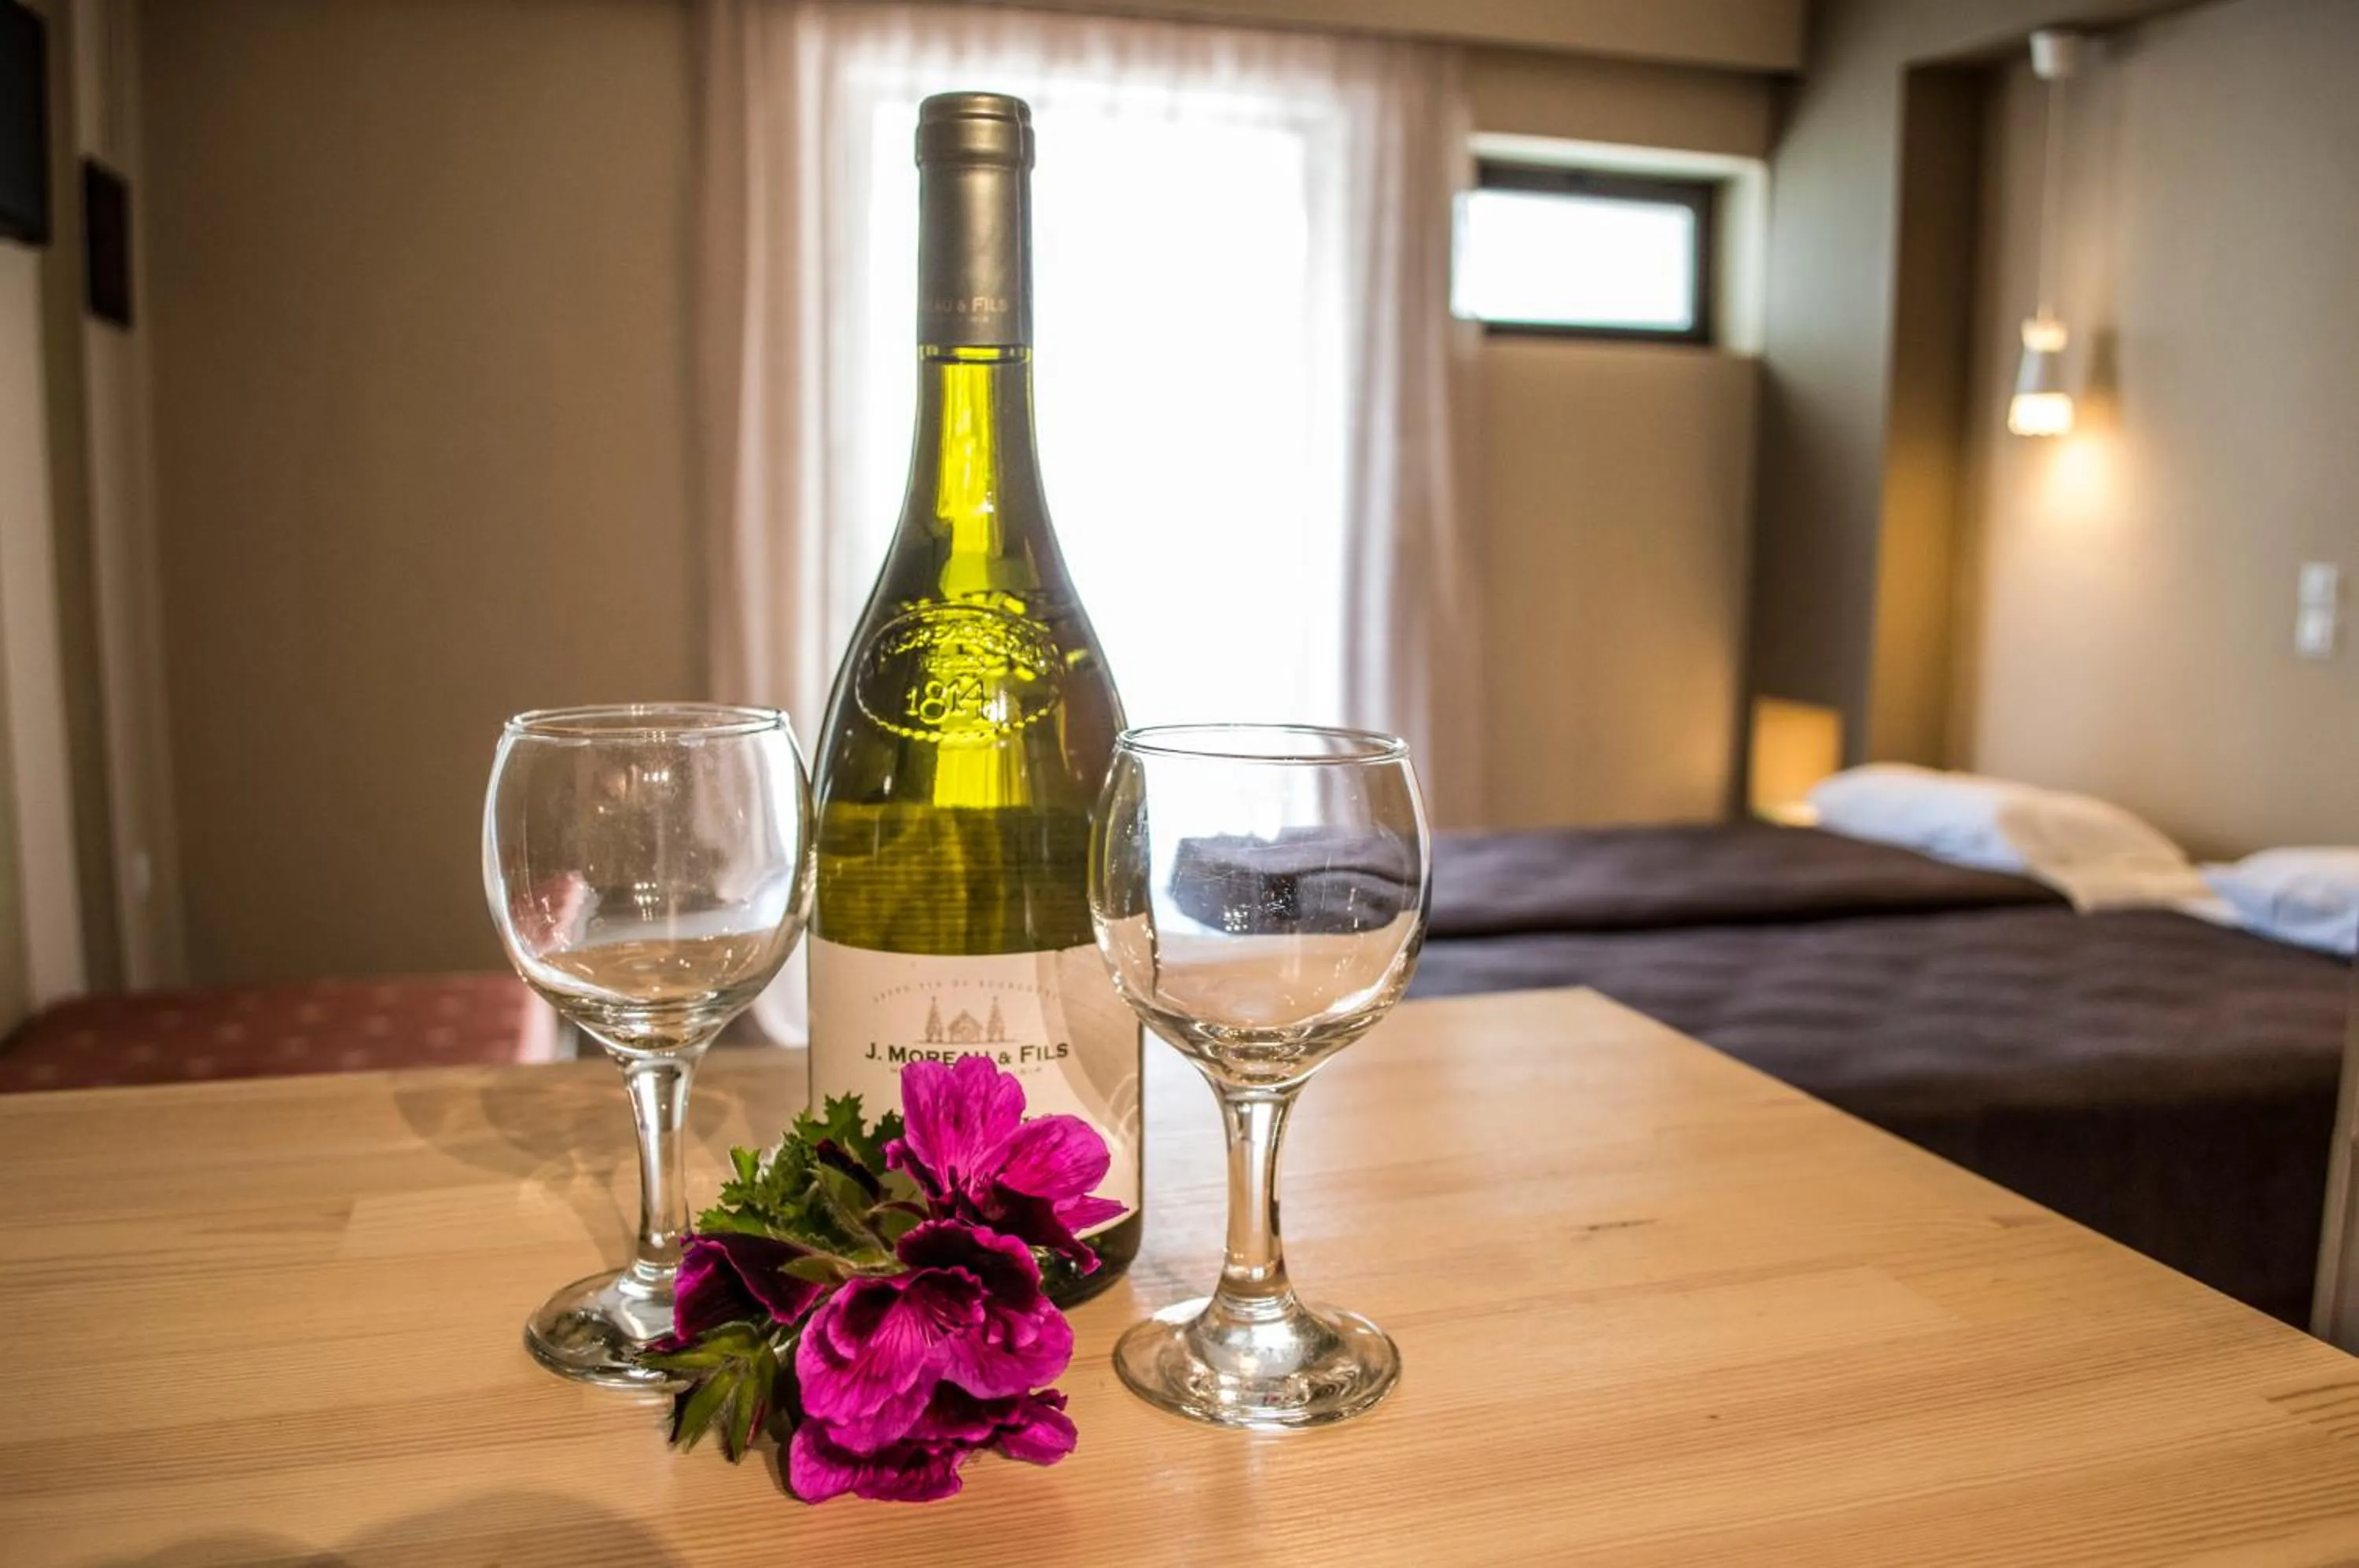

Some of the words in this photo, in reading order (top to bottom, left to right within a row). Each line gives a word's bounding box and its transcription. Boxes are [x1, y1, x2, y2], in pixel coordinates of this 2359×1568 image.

[972, 296, 1010, 313] FILS
[865, 1042, 882, 1060] J.
[888, 1044, 991, 1066] MORE
[998, 1051, 1011, 1065] &
[1020, 1042, 1069, 1063] FILS
